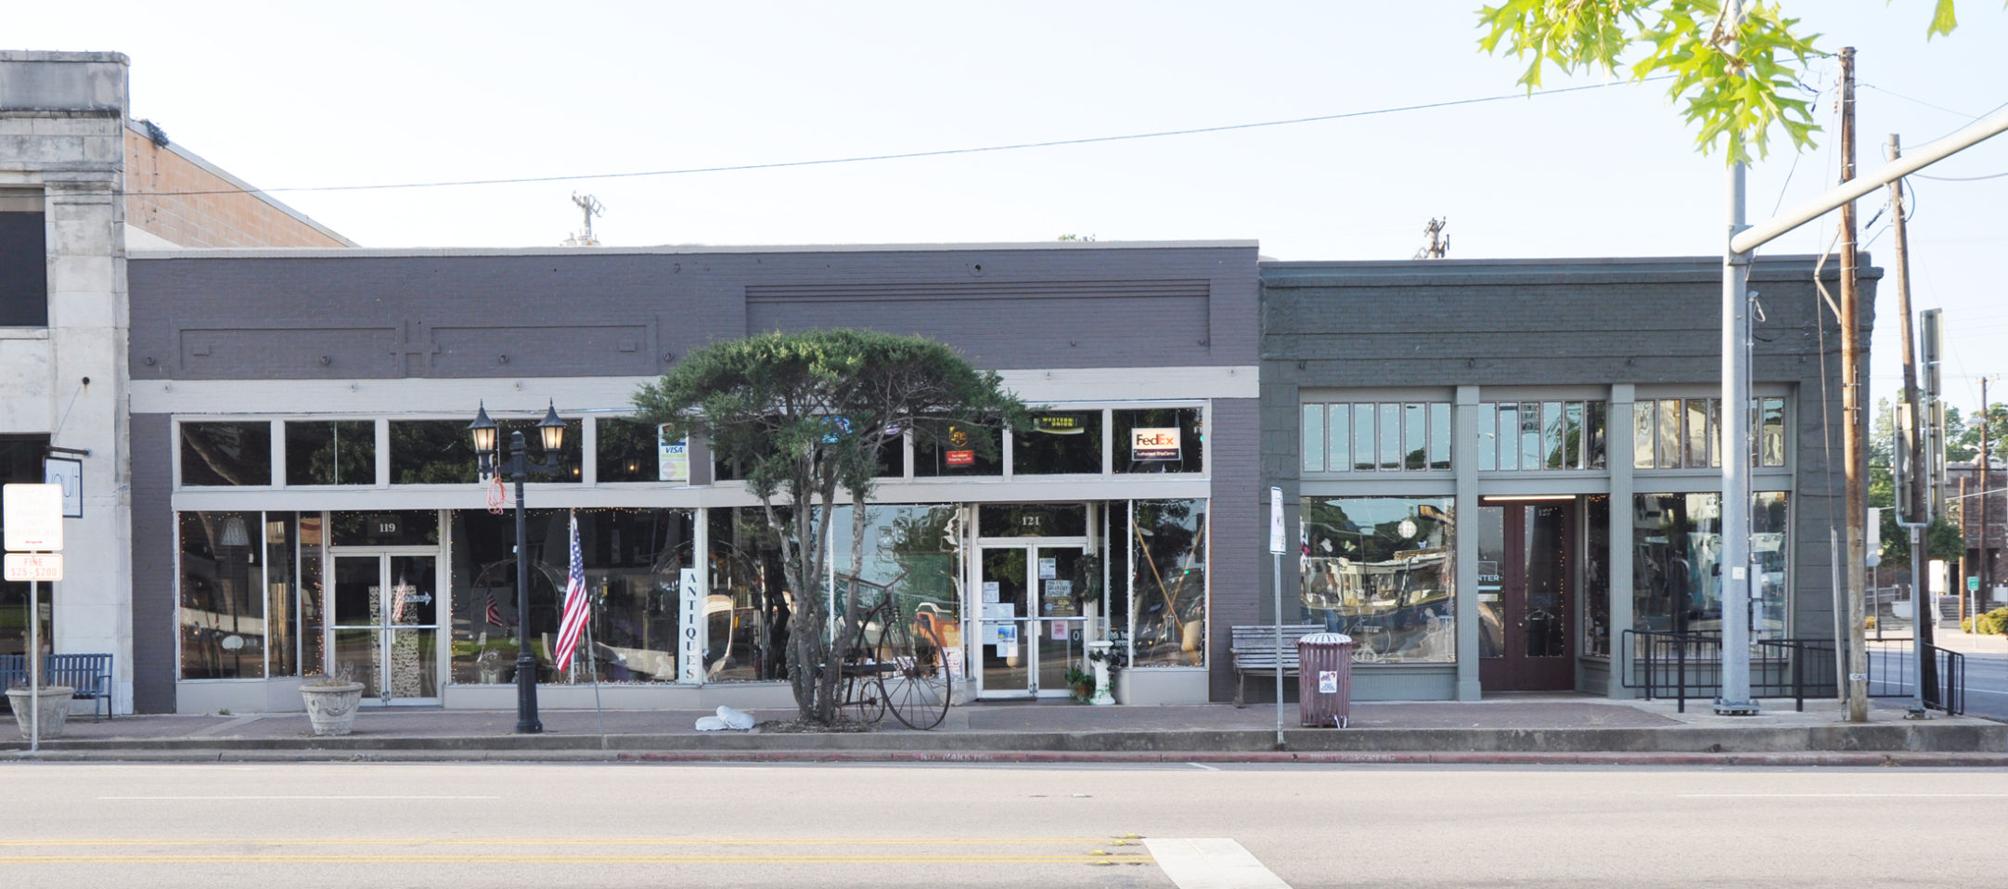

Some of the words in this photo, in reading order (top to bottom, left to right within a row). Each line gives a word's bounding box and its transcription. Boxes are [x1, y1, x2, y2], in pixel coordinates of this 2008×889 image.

[1136, 433, 1174, 446] FedEx
[664, 446, 684, 454] VISA
[1022, 516, 1039, 526] 121
[379, 522, 396, 533] 119
[24, 557, 43, 566] FINE
[685, 573, 697, 680] ANTIQUES
